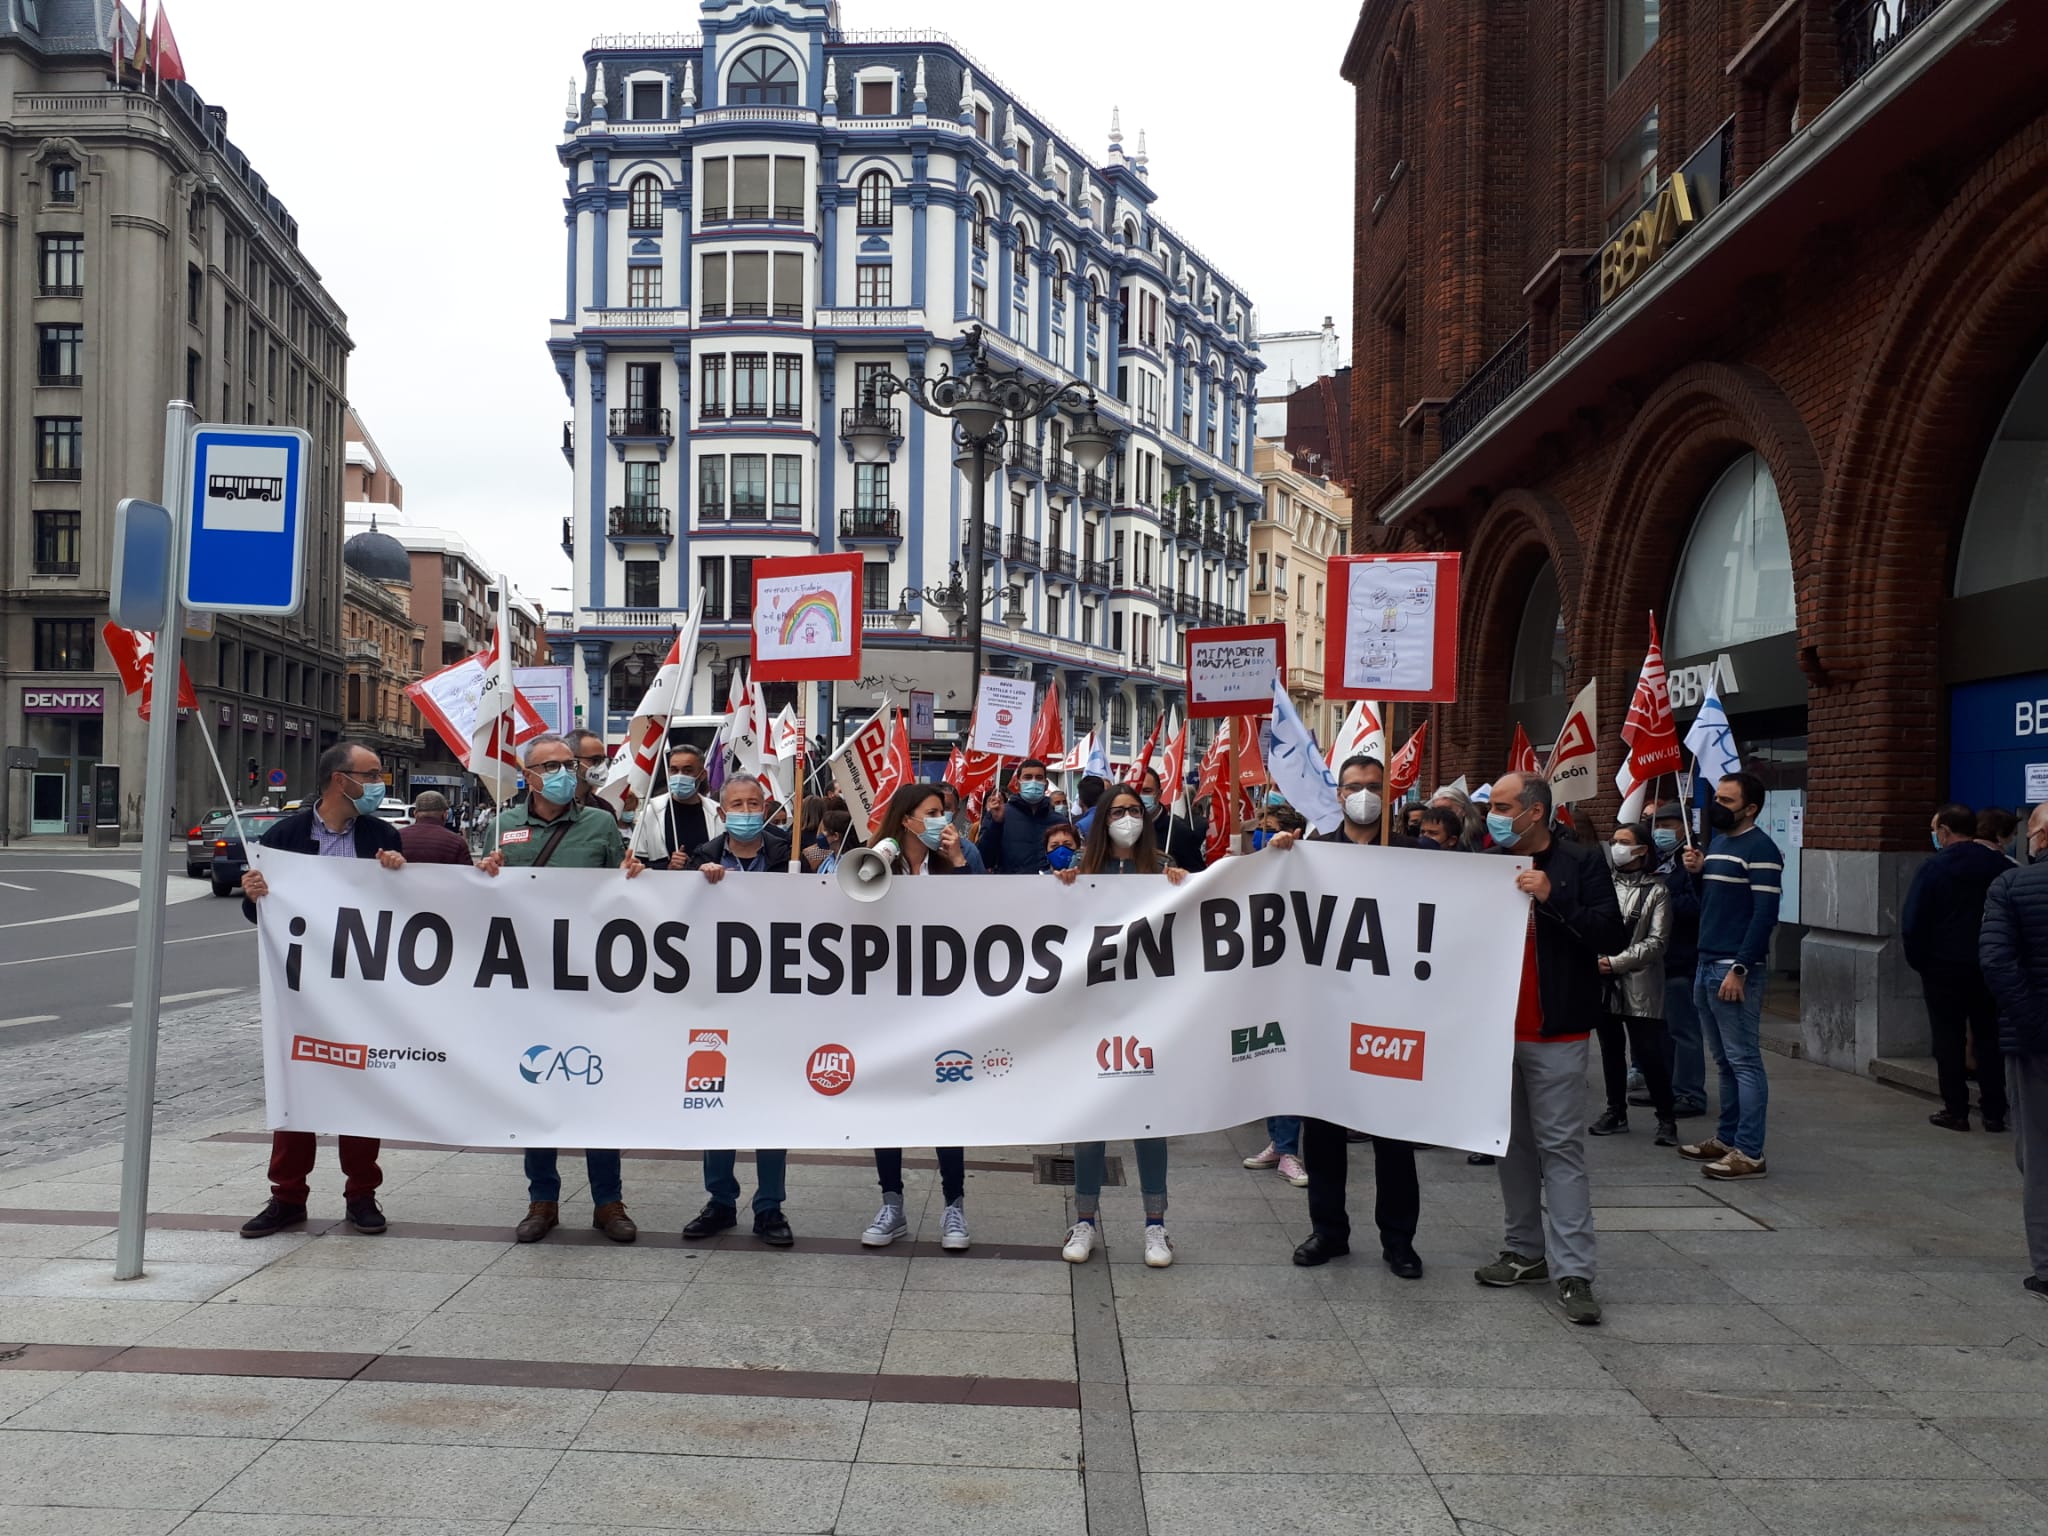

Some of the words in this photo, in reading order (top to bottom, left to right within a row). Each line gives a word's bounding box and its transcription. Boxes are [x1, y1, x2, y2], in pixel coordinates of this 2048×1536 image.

[1602, 173, 1694, 301] BBVA
[1197, 648, 1216, 659] MI
[1670, 653, 1740, 709] BBVA
[25, 693, 101, 708] DENTIX
[997, 714, 1012, 722] STOP
[1638, 745, 1681, 766] www.ug
[331, 907, 454, 986] NO
[473, 917, 529, 989] A
[553, 919, 690, 993] LOS
[716, 920, 1068, 996] DESPIDOS
[1086, 912, 1177, 987] EN
[1200, 890, 1390, 977] BBVA
[1231, 1021, 1286, 1056] ELA
[1356, 1034, 1418, 1062] SCAT
[297, 1040, 362, 1065] CCOO
[367, 1046, 447, 1062] servicios
[814, 1052, 851, 1073] UGT
[987, 1057, 1009, 1067] CIC
[1096, 1035, 1154, 1072] CIG
[366, 1058, 397, 1070] bbva
[688, 1077, 723, 1090] CGT
[683, 1097, 724, 1110] BBVA
